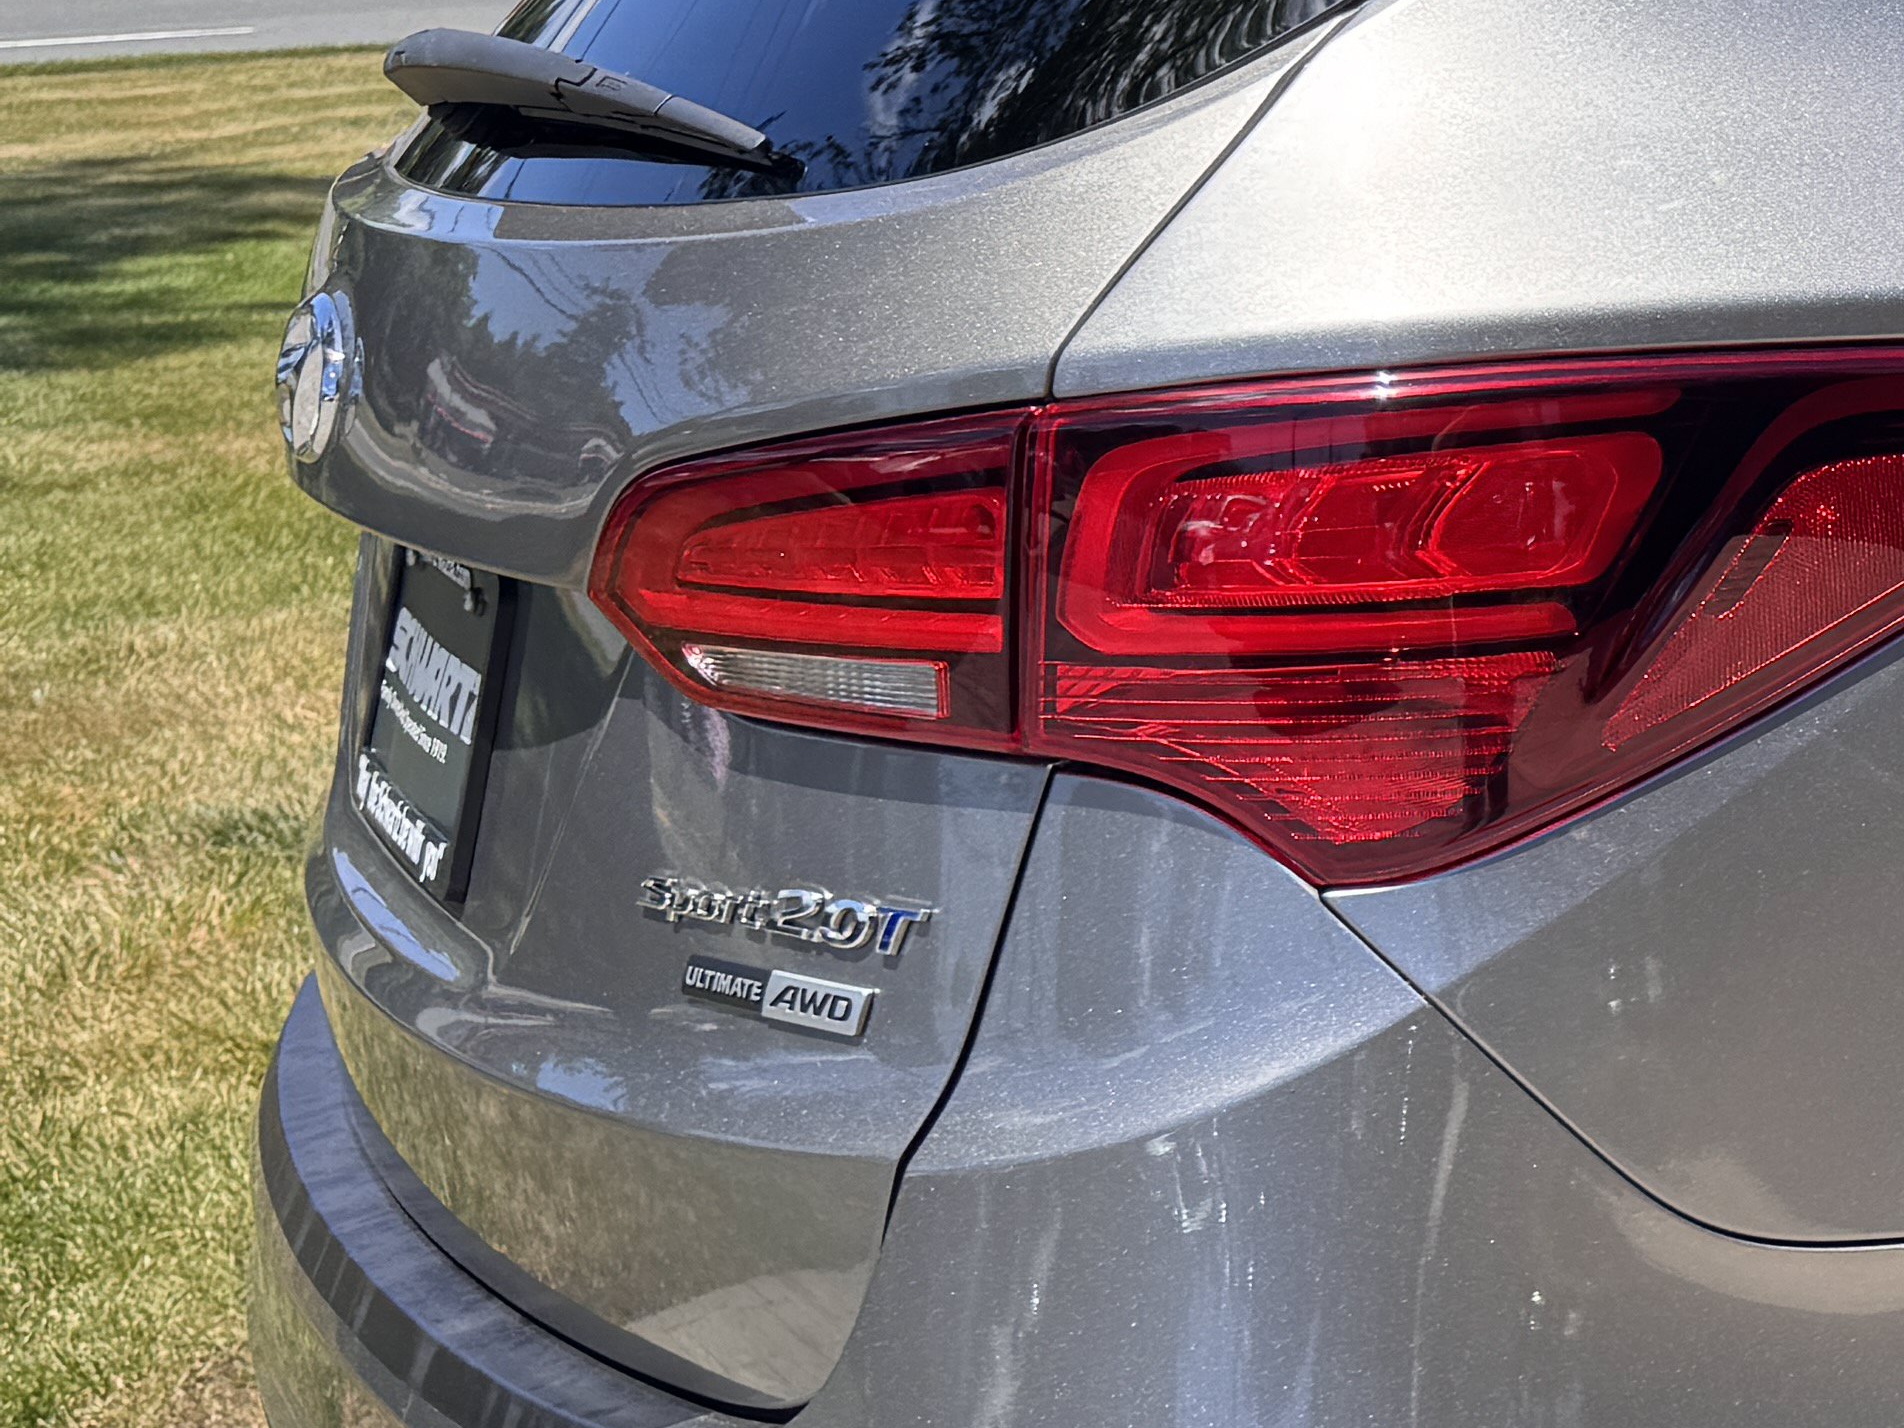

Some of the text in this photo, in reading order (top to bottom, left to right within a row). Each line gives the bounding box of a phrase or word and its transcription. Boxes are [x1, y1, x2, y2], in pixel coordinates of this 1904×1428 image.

[638, 874, 774, 928] Sport
[685, 965, 762, 1002] ULTIMATE
[769, 985, 853, 1022] AWD
